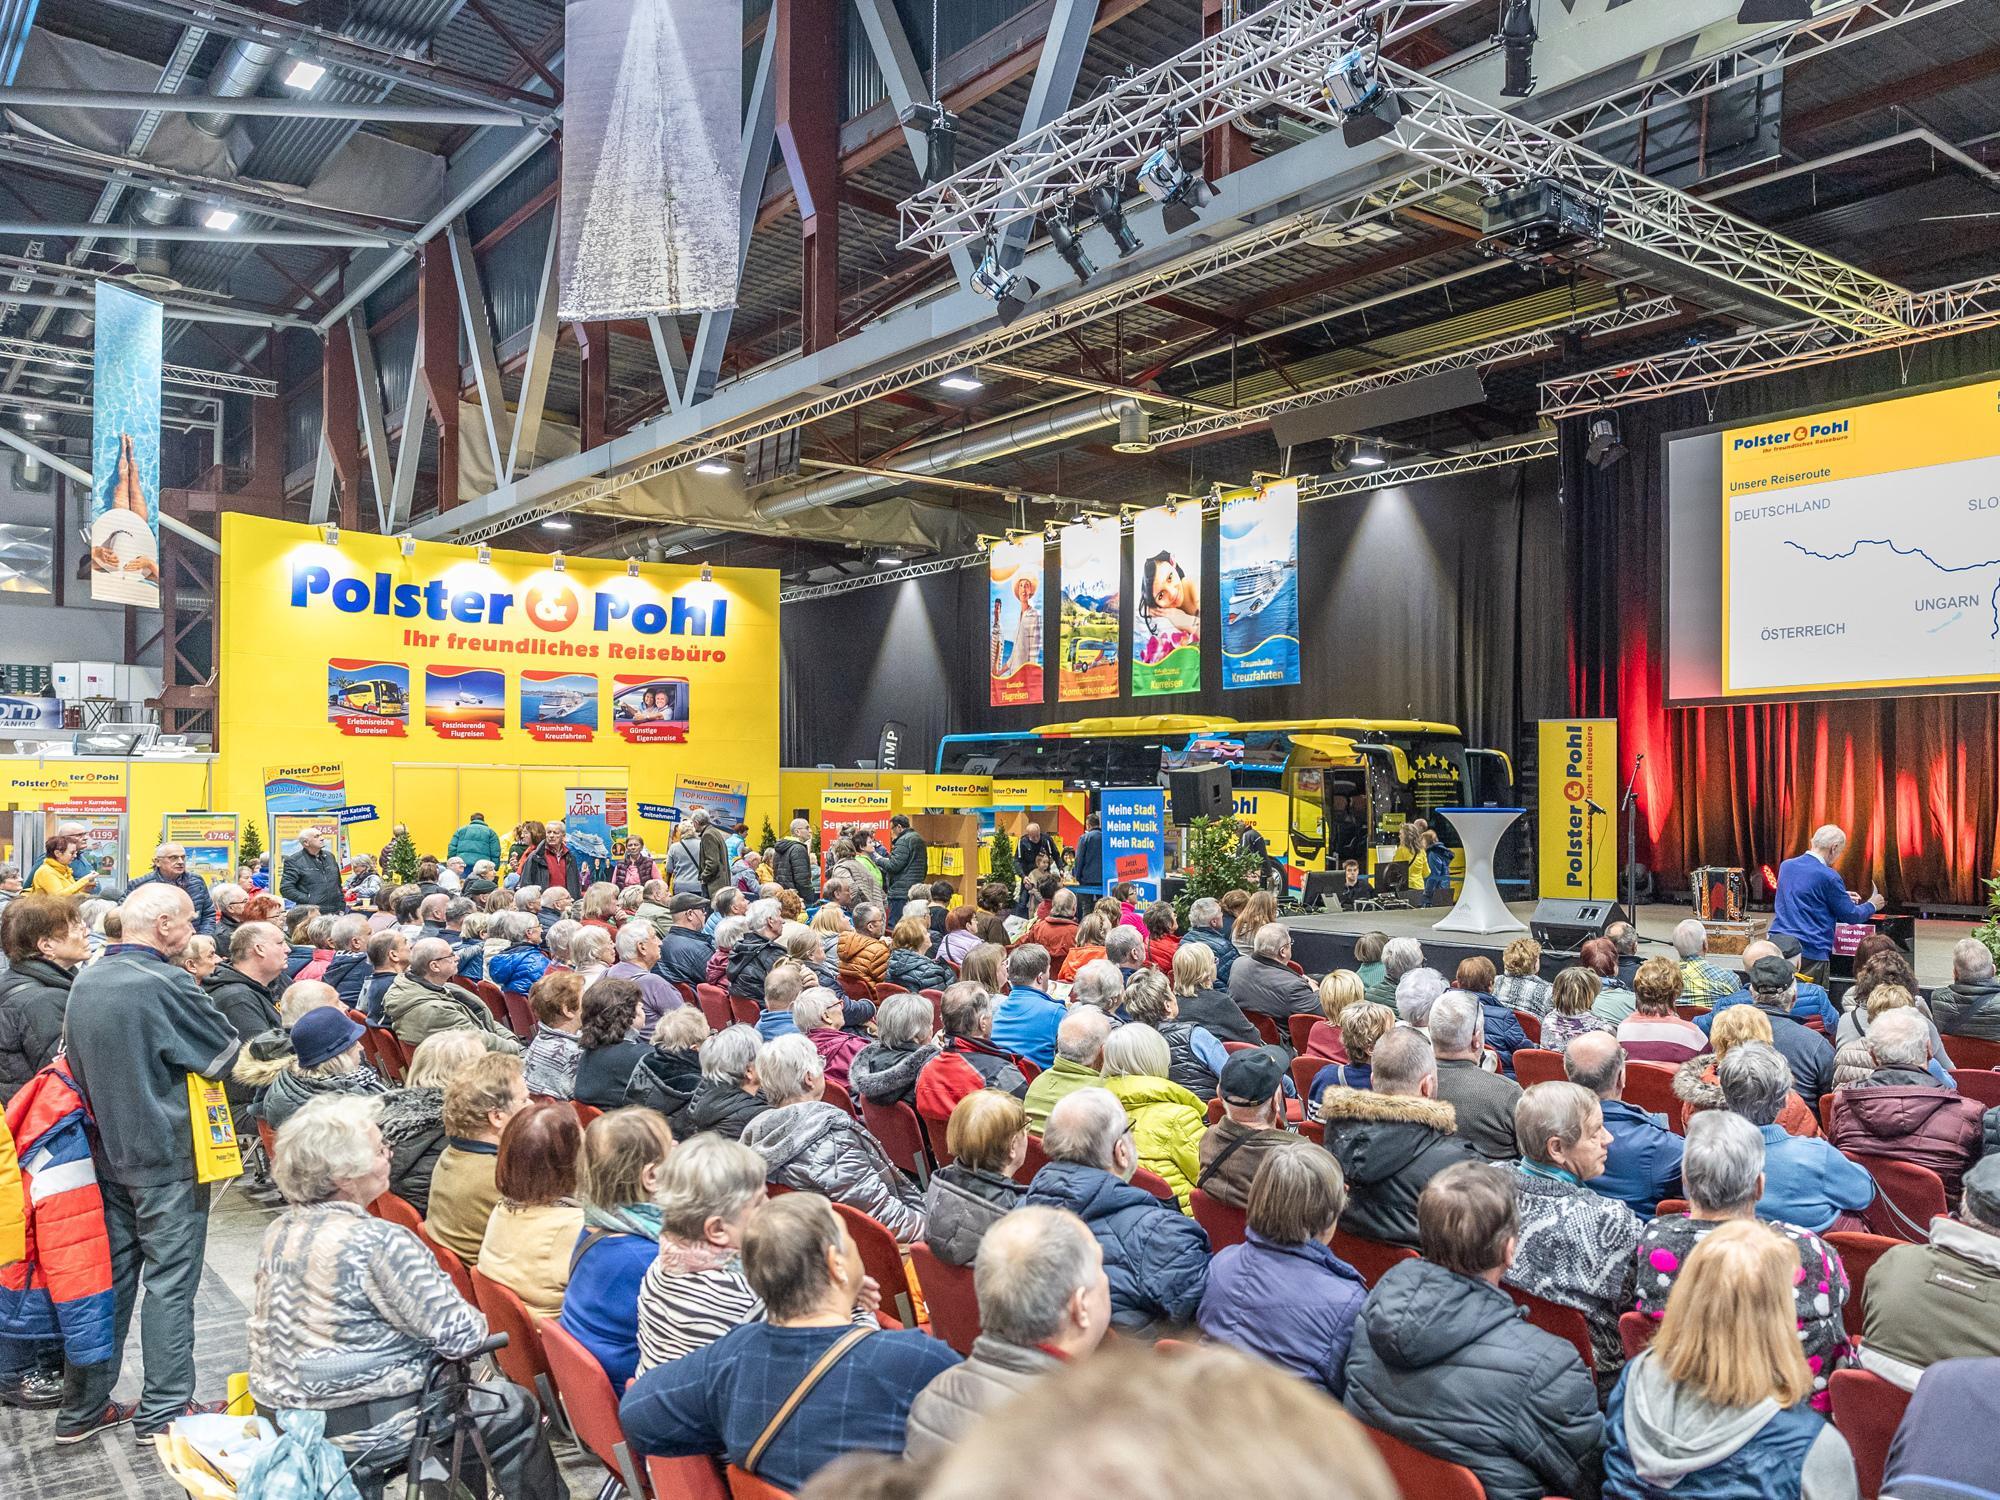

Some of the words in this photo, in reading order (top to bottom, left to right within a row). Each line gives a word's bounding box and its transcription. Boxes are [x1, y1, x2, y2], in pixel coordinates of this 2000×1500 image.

[1733, 432, 1791, 451] Polster
[1810, 420, 1848, 438] Pohl
[1730, 478, 1768, 492] Unsere
[1771, 468, 1831, 485] Reiseroute
[1968, 496, 2000, 512] SLO
[1734, 498, 1831, 522] DEUTSCHLAND
[291, 562, 514, 625] Polster
[593, 591, 728, 637] Pohl
[1914, 594, 1979, 612] UNGARN
[1761, 622, 1846, 641] ÖSTERREICH
[403, 629, 440, 648] Ihr
[447, 632, 600, 658] freundliches
[608, 642, 727, 663] Reisebüro
[1231, 671, 1284, 683] Kreuzfahrten
[347, 717, 395, 726] Erlebnisreiche
[442, 721, 486, 729] Faszinierende
[354, 726, 388, 735] Busreisen
[450, 729, 485, 738] Flugreisen
[535, 724, 573, 732] Traumhafte
[629, 727, 658, 735] Günstige
[544, 732, 587, 740] Kreuzfahrten
[636, 734, 677, 743] Eigenanreise
[1566, 726, 1583, 778] Pohl
[279, 767, 311, 776] Polster
[320, 764, 341, 772] Pohl
[683, 778, 708, 786] Polster
[935, 784, 967, 792] Polster
[824, 796, 857, 804] Polster
[867, 796, 889, 804] Pohl
[1231, 796, 1258, 814] ohl
[569, 804, 600, 816] KARAT
[643, 811, 676, 820] mitnehmen!
[1107, 804, 1132, 816] Meine
[341, 812, 372, 823] itnehmen!
[1106, 820, 1131, 832] Meine
[92, 831, 118, 840] 1199,-
[208, 832, 235, 841] 1746,-
[1110, 837, 1130, 848] Mein
[1566, 804, 1583, 887] Polster
